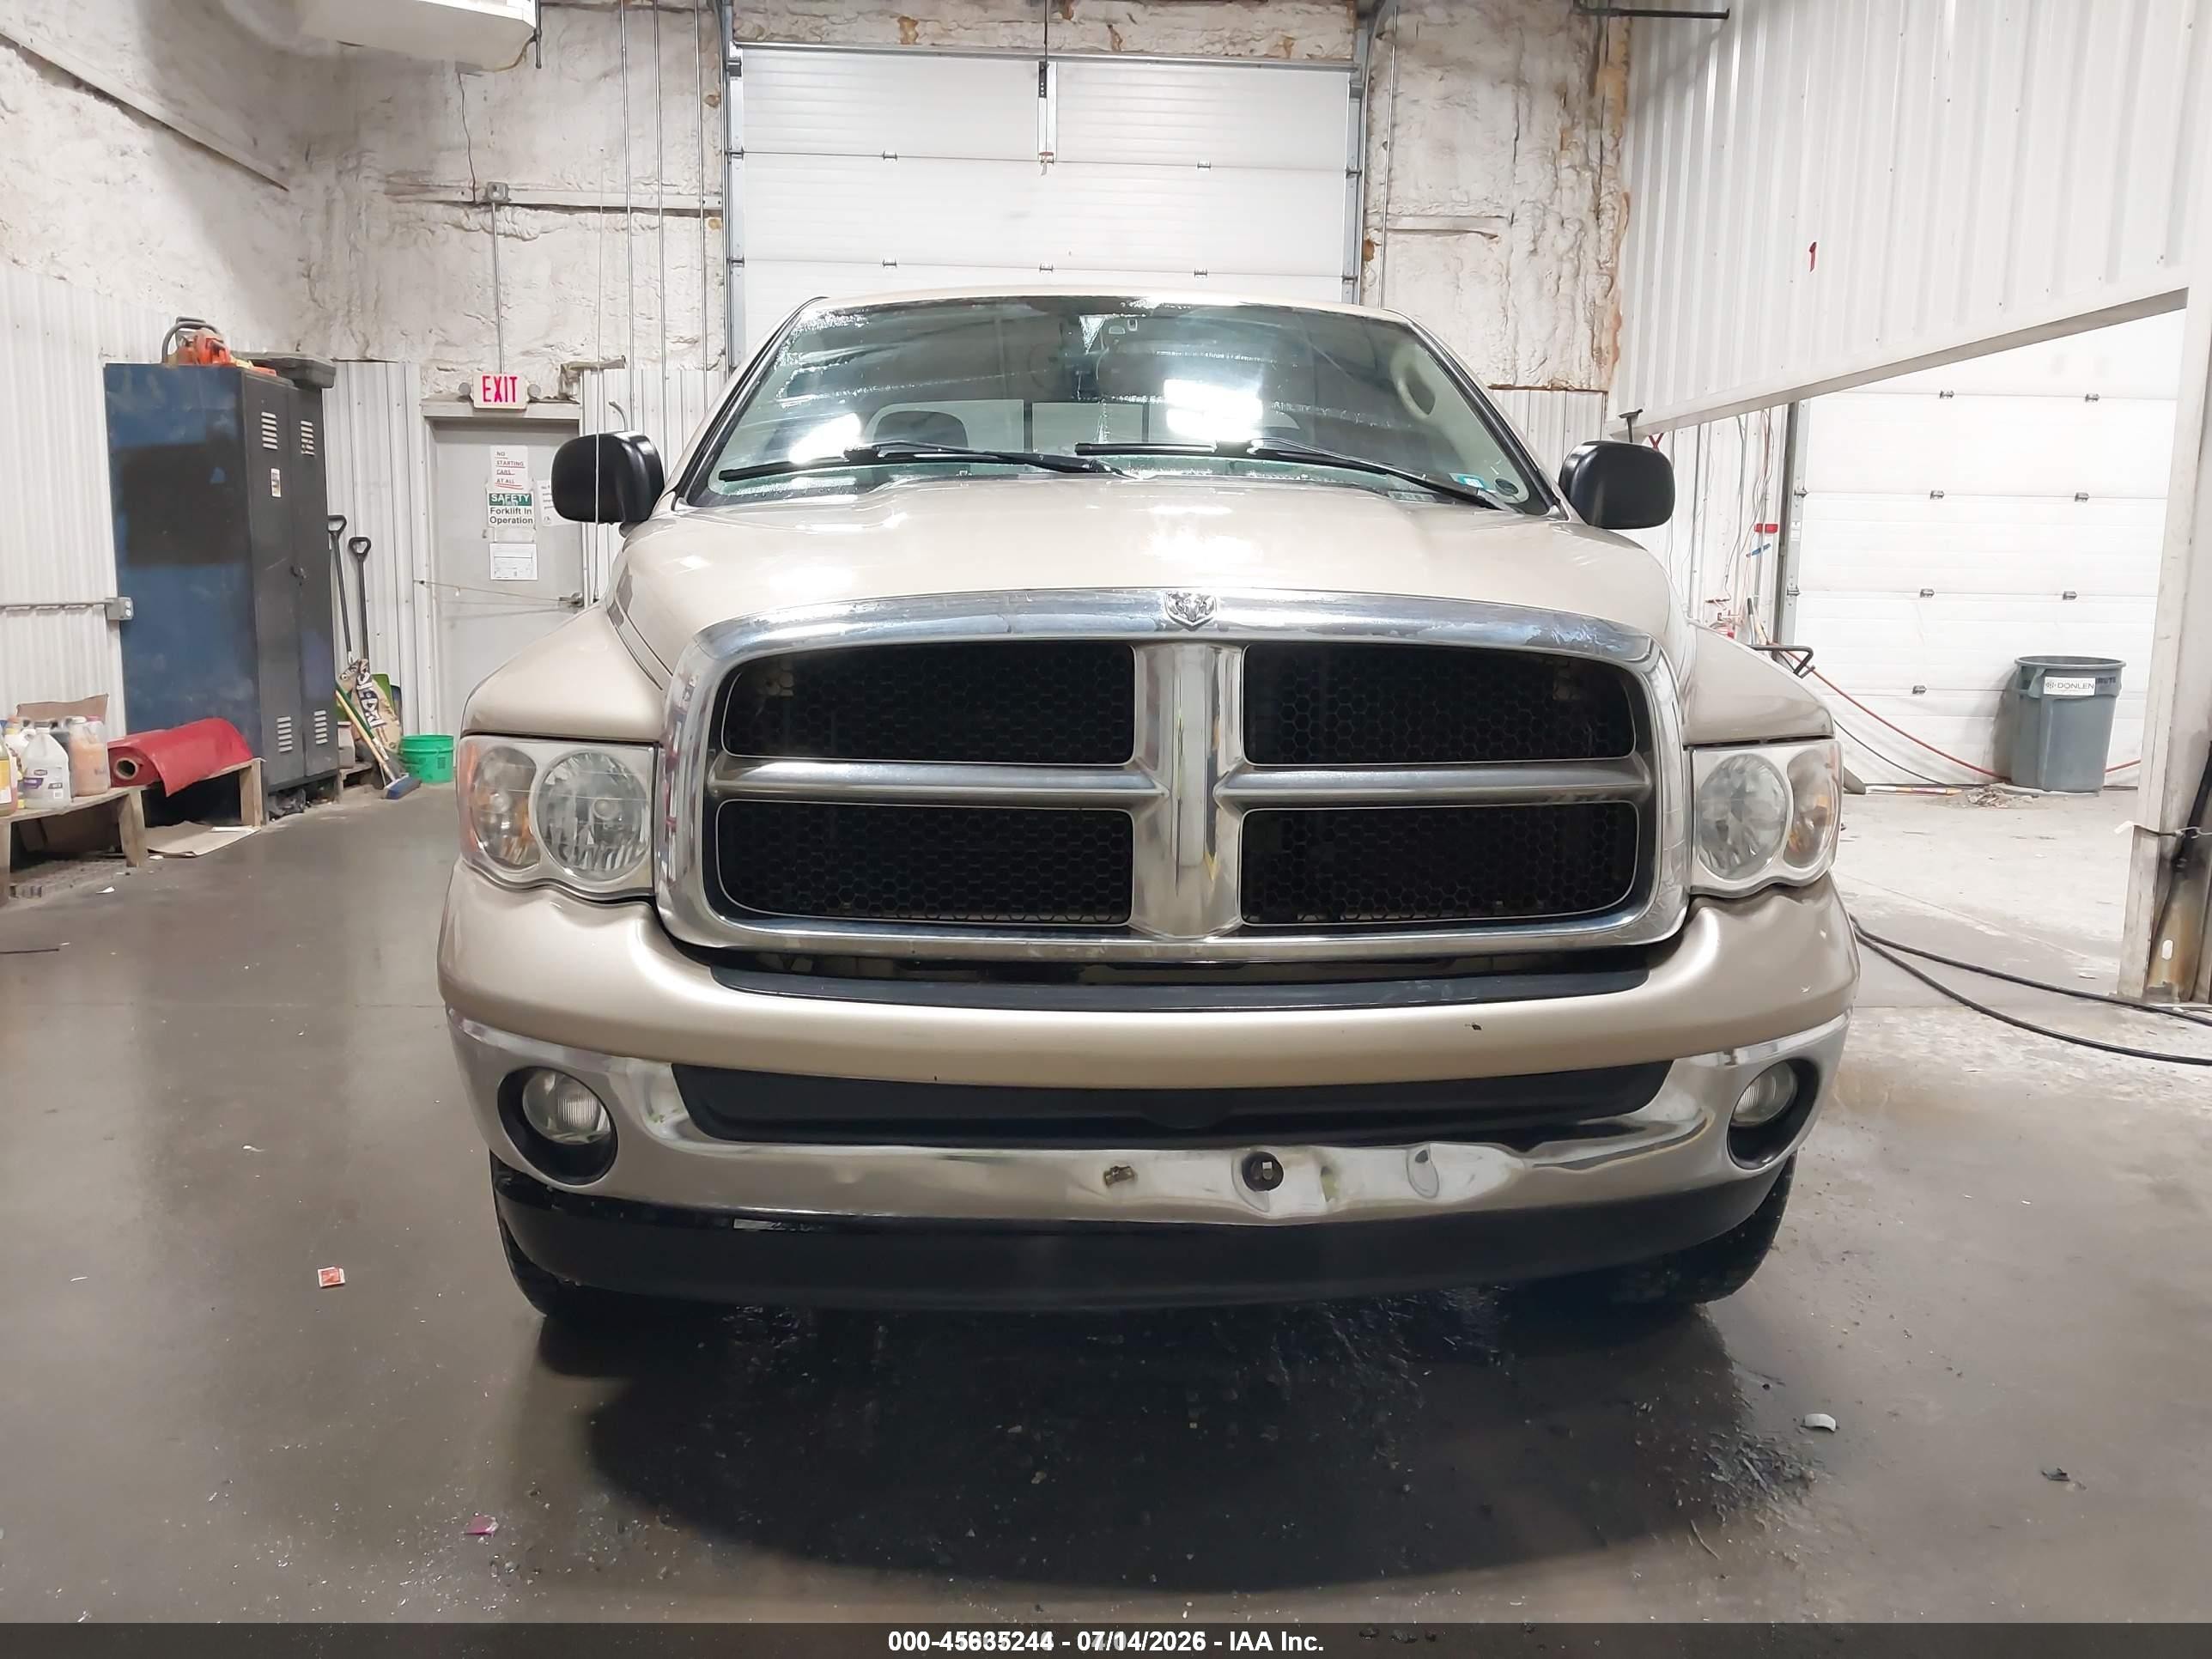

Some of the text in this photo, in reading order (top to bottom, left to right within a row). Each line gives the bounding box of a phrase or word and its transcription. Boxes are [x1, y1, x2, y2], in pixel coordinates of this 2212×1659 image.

[482, 375, 518, 403] EXIT
[490, 494, 530, 502] SAFETY
[489, 507, 521, 515] Forklift
[489, 516, 533, 525] Operation
[2057, 681, 2094, 690] DONLEN
